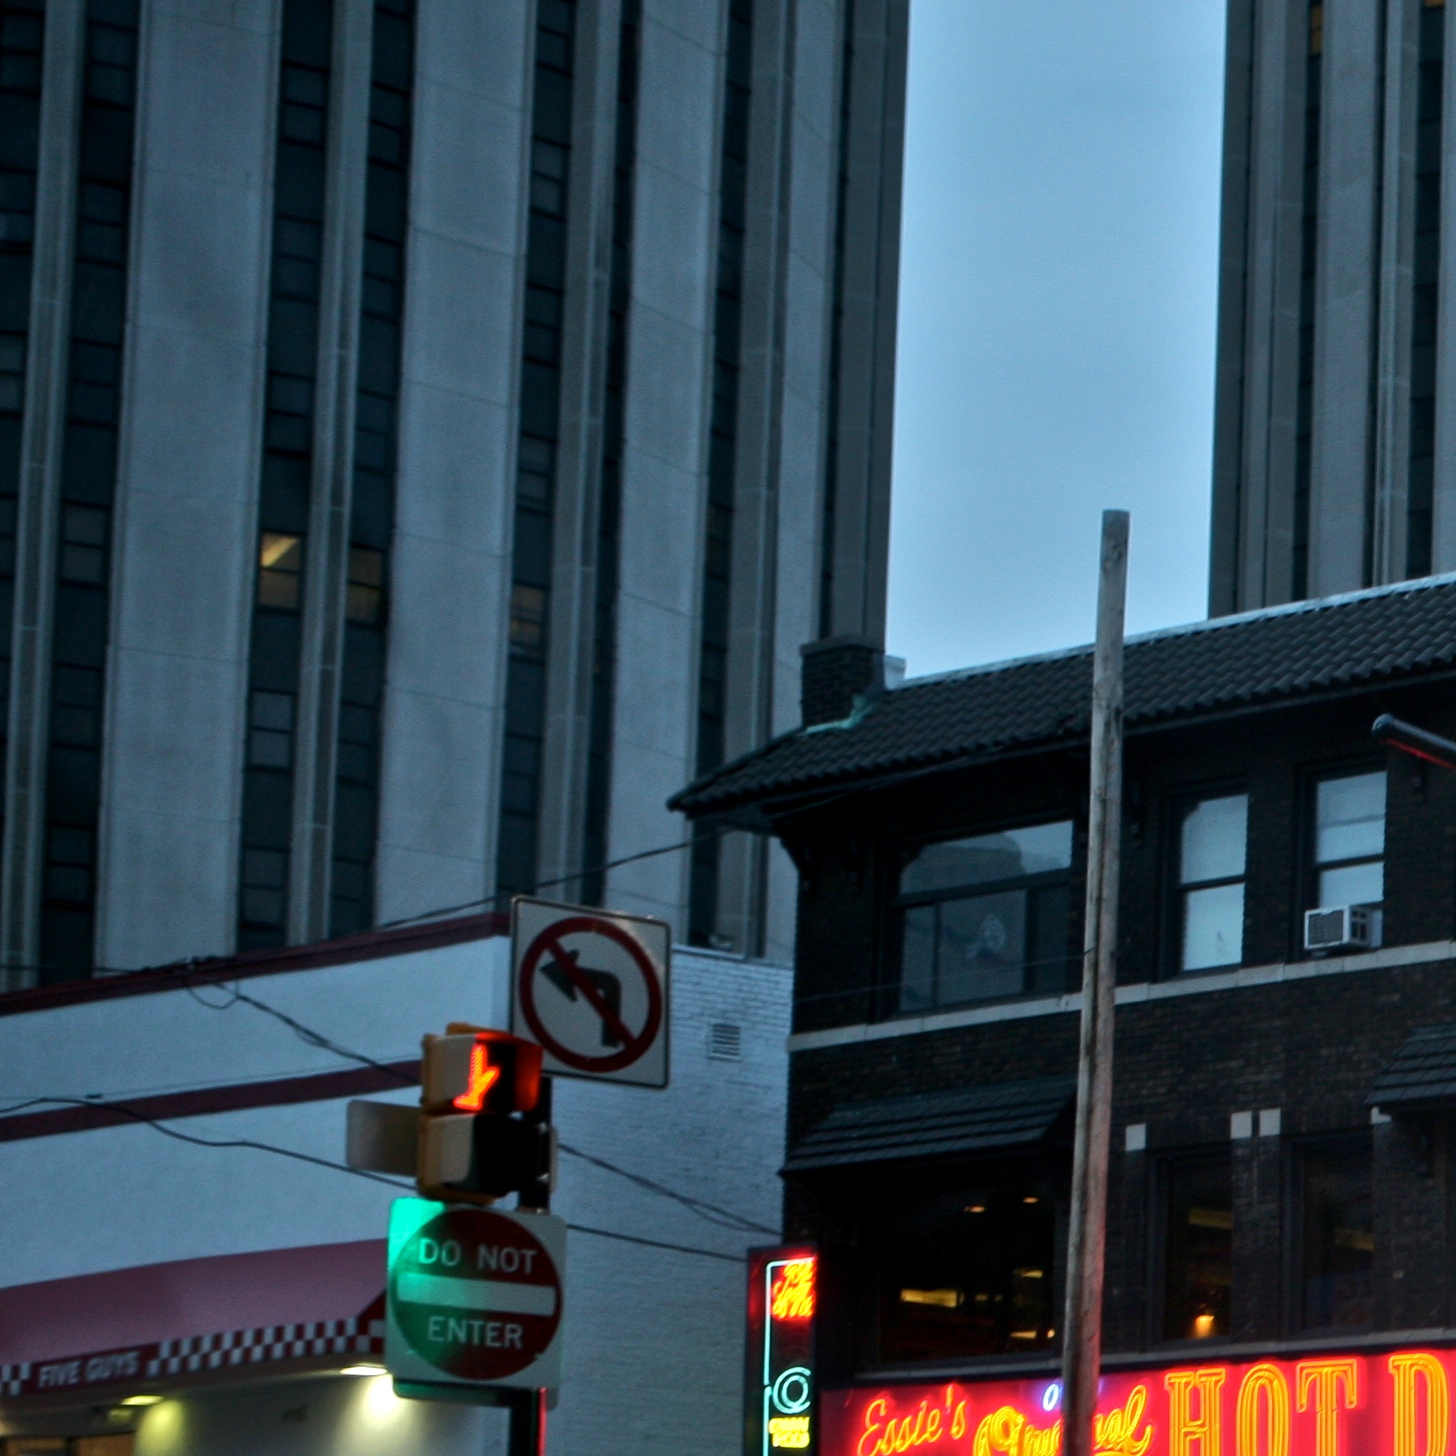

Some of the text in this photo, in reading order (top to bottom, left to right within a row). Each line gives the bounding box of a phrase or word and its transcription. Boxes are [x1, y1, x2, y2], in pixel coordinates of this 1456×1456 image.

[418, 1237, 538, 1274] DO NOT
[428, 1315, 524, 1349] ENTER
[38, 1351, 140, 1388] FIVE GUYS
